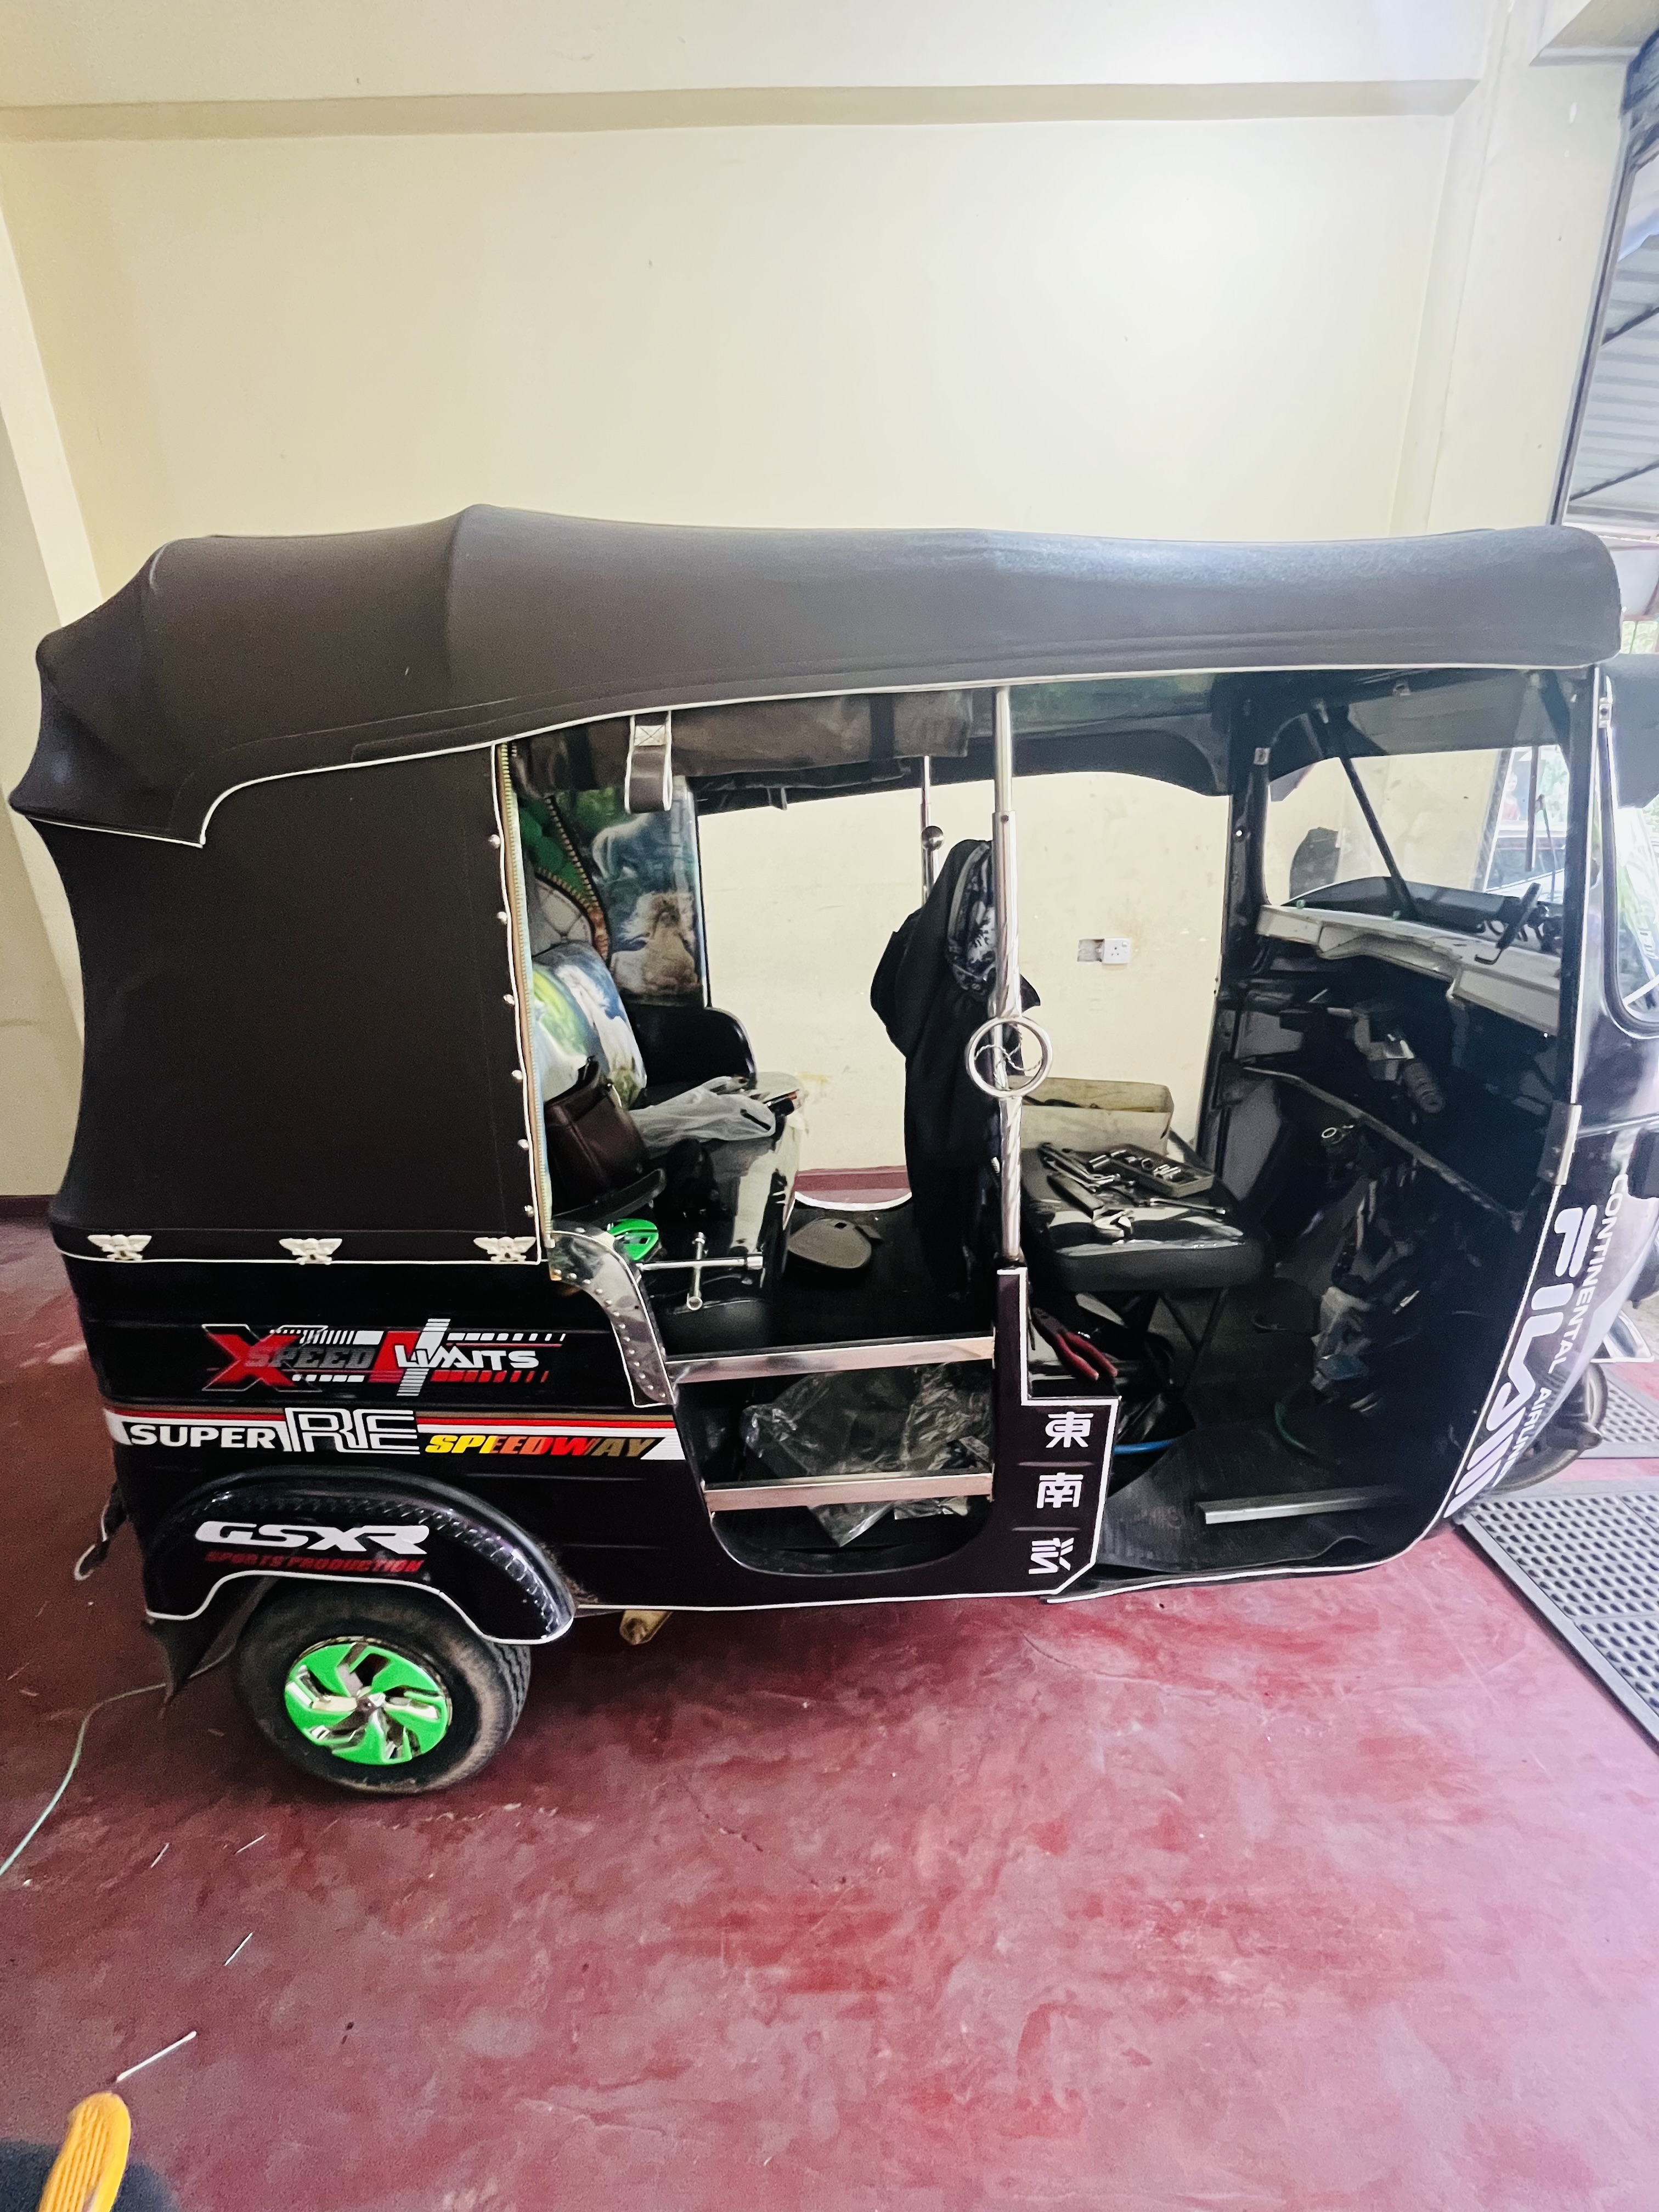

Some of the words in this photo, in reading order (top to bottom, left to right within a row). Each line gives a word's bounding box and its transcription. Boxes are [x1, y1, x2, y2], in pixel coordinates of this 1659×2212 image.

[1548, 1173, 1628, 1374] CONTINENTAL
[129, 1424, 276, 1449] SUPER
[284, 1407, 421, 1455] RE
[424, 1434, 659, 1458] SPEEDWAY
[195, 1520, 430, 1555] GSXR
